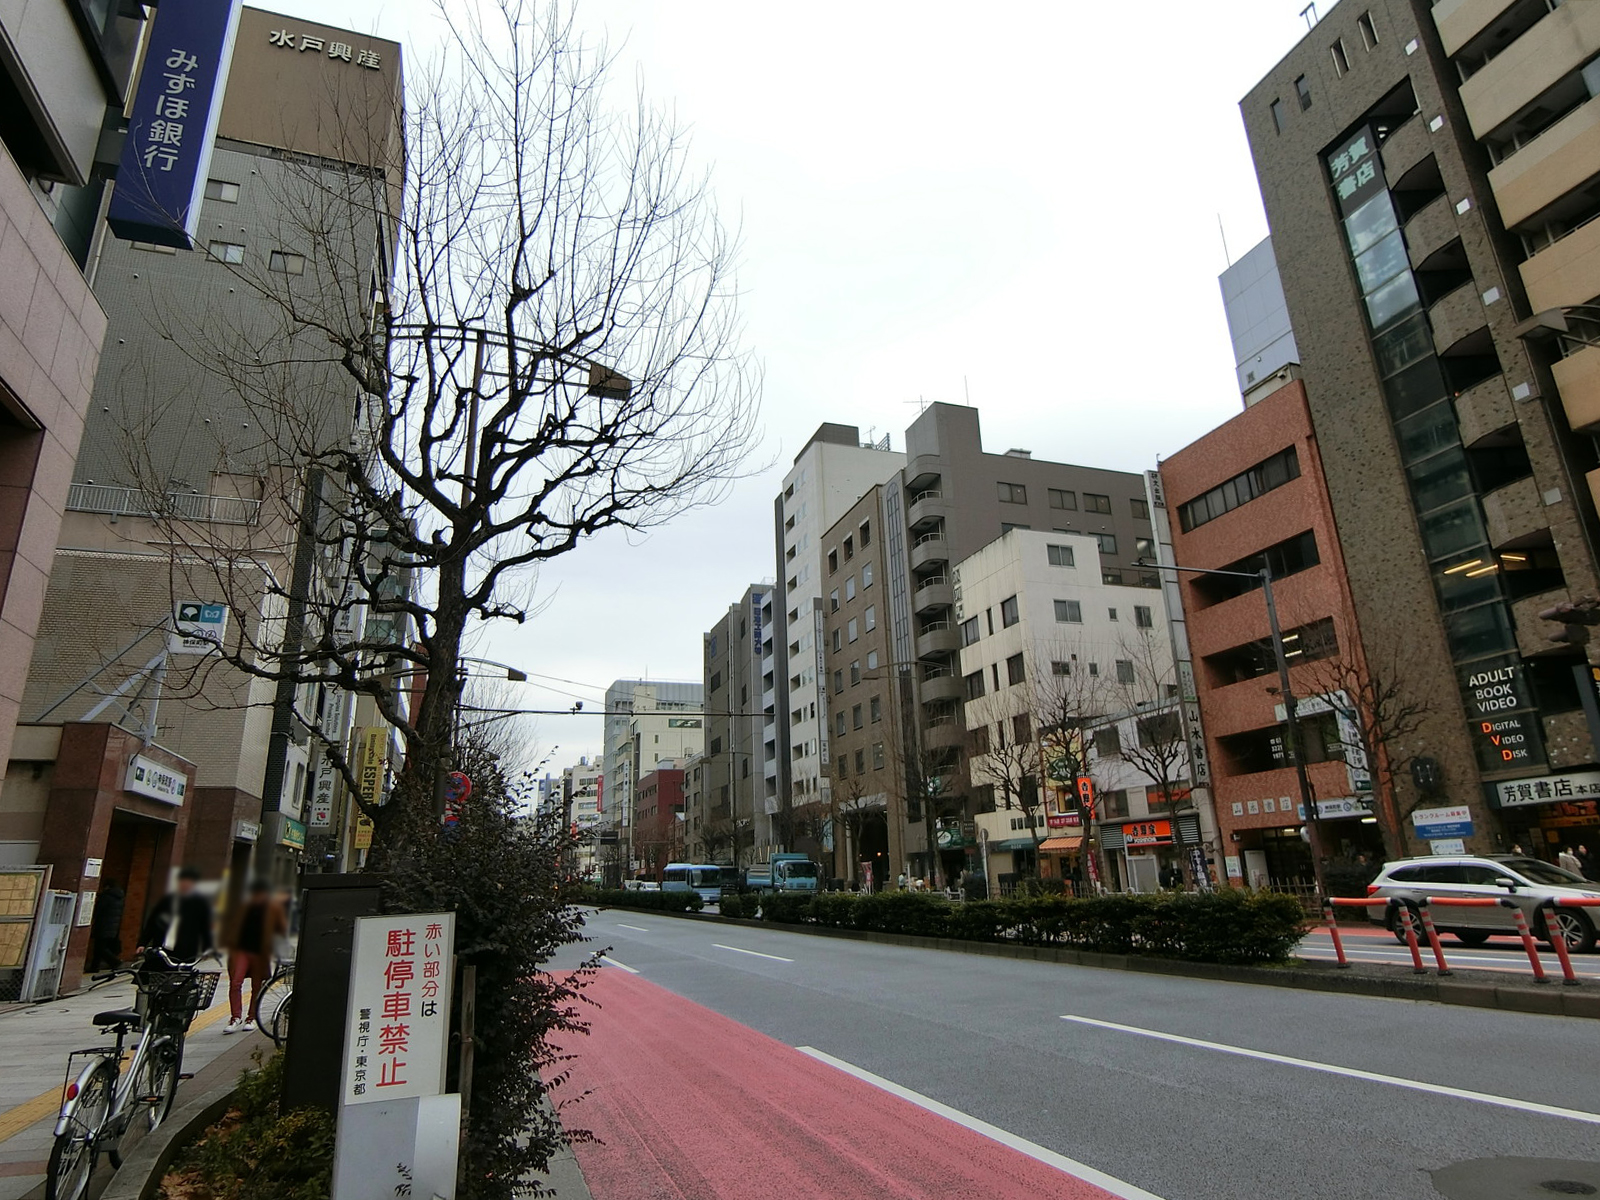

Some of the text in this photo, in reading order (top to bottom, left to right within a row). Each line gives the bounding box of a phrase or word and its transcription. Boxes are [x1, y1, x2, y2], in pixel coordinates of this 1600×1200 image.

[269, 29, 382, 71] 水戸興産
[143, 48, 199, 172] みずほ銀行
[1331, 136, 1369, 178] 芳賀
[1338, 160, 1375, 200] 書店
[1469, 666, 1514, 687] ADULT
[1475, 683, 1512, 700] BOOK
[1477, 696, 1517, 712] VIDEO
[1482, 719, 1521, 733] DIGITAL
[1490, 734, 1524, 746] VIDEO
[1502, 748, 1528, 761] DISK
[316, 754, 333, 804] 水戸興産
[1503, 779, 1600, 803] 芳賀書店 本店
[420, 922, 443, 1017] 赤い部分は
[375, 928, 417, 1088] 駐停車禁止
[353, 1007, 372, 1096] 警視庁・東京都
